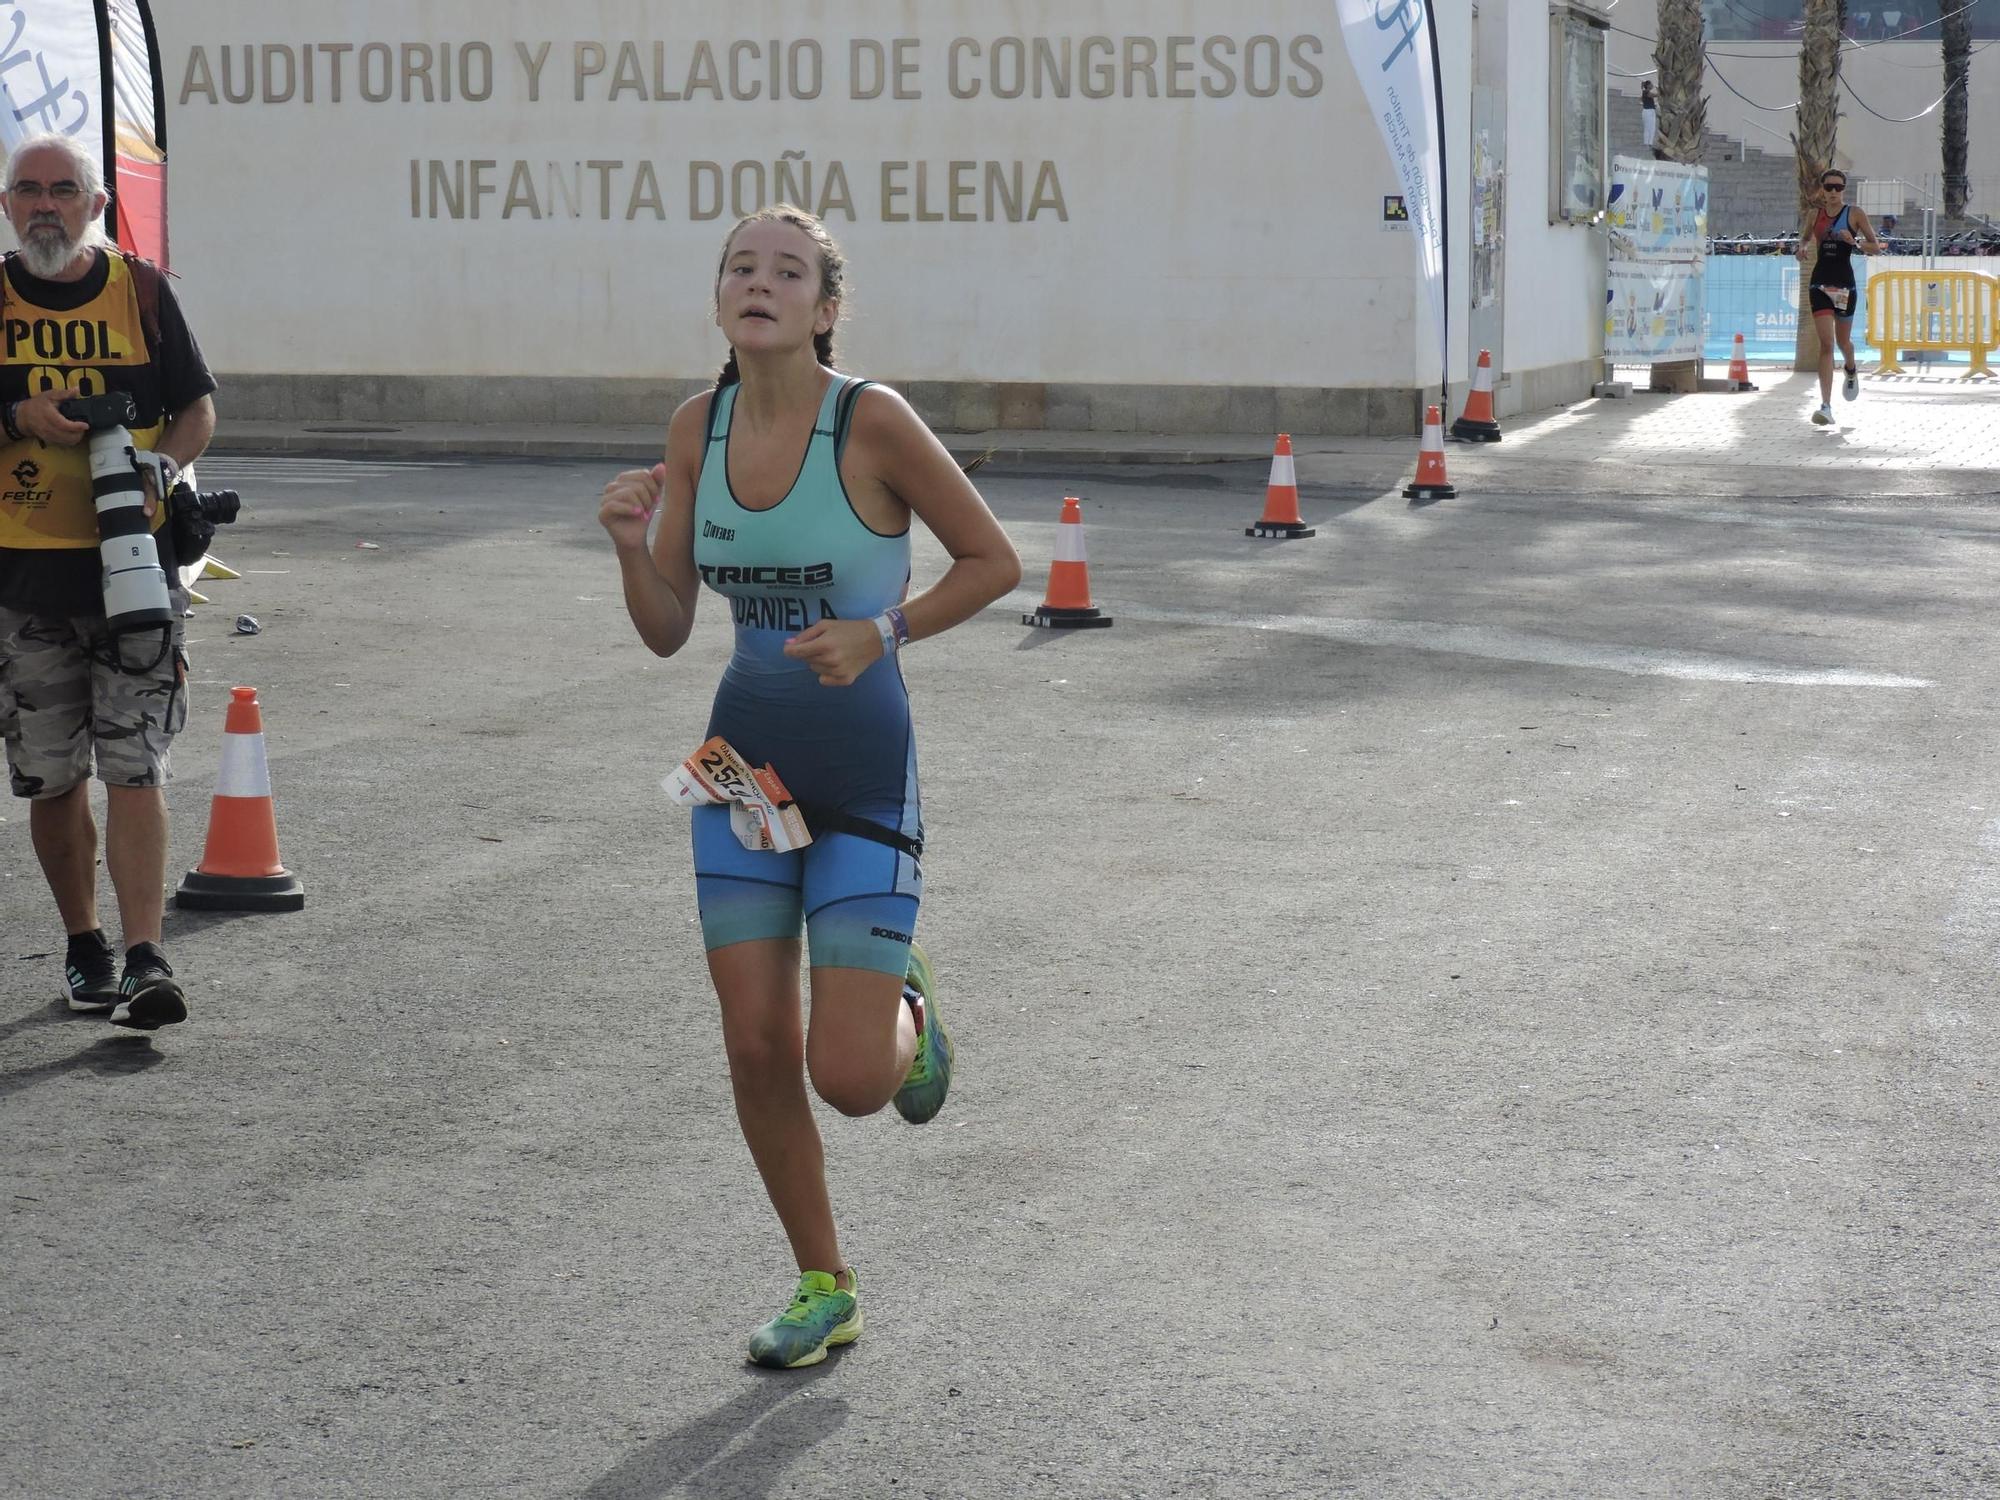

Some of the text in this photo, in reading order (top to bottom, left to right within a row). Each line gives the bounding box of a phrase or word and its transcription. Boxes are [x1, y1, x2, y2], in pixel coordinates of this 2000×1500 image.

[178, 40, 493, 105] AUDITORIO
[514, 40, 552, 102] Y
[574, 38, 823, 102] PALACIO
[849, 37, 922, 100] DE
[947, 34, 1324, 99] CONGRESOS
[688, 149, 857, 222] DOÑA
[880, 159, 1069, 223] ELENA
[6, 318, 122, 360] POOL
[732, 595, 839, 632] DANIELA
